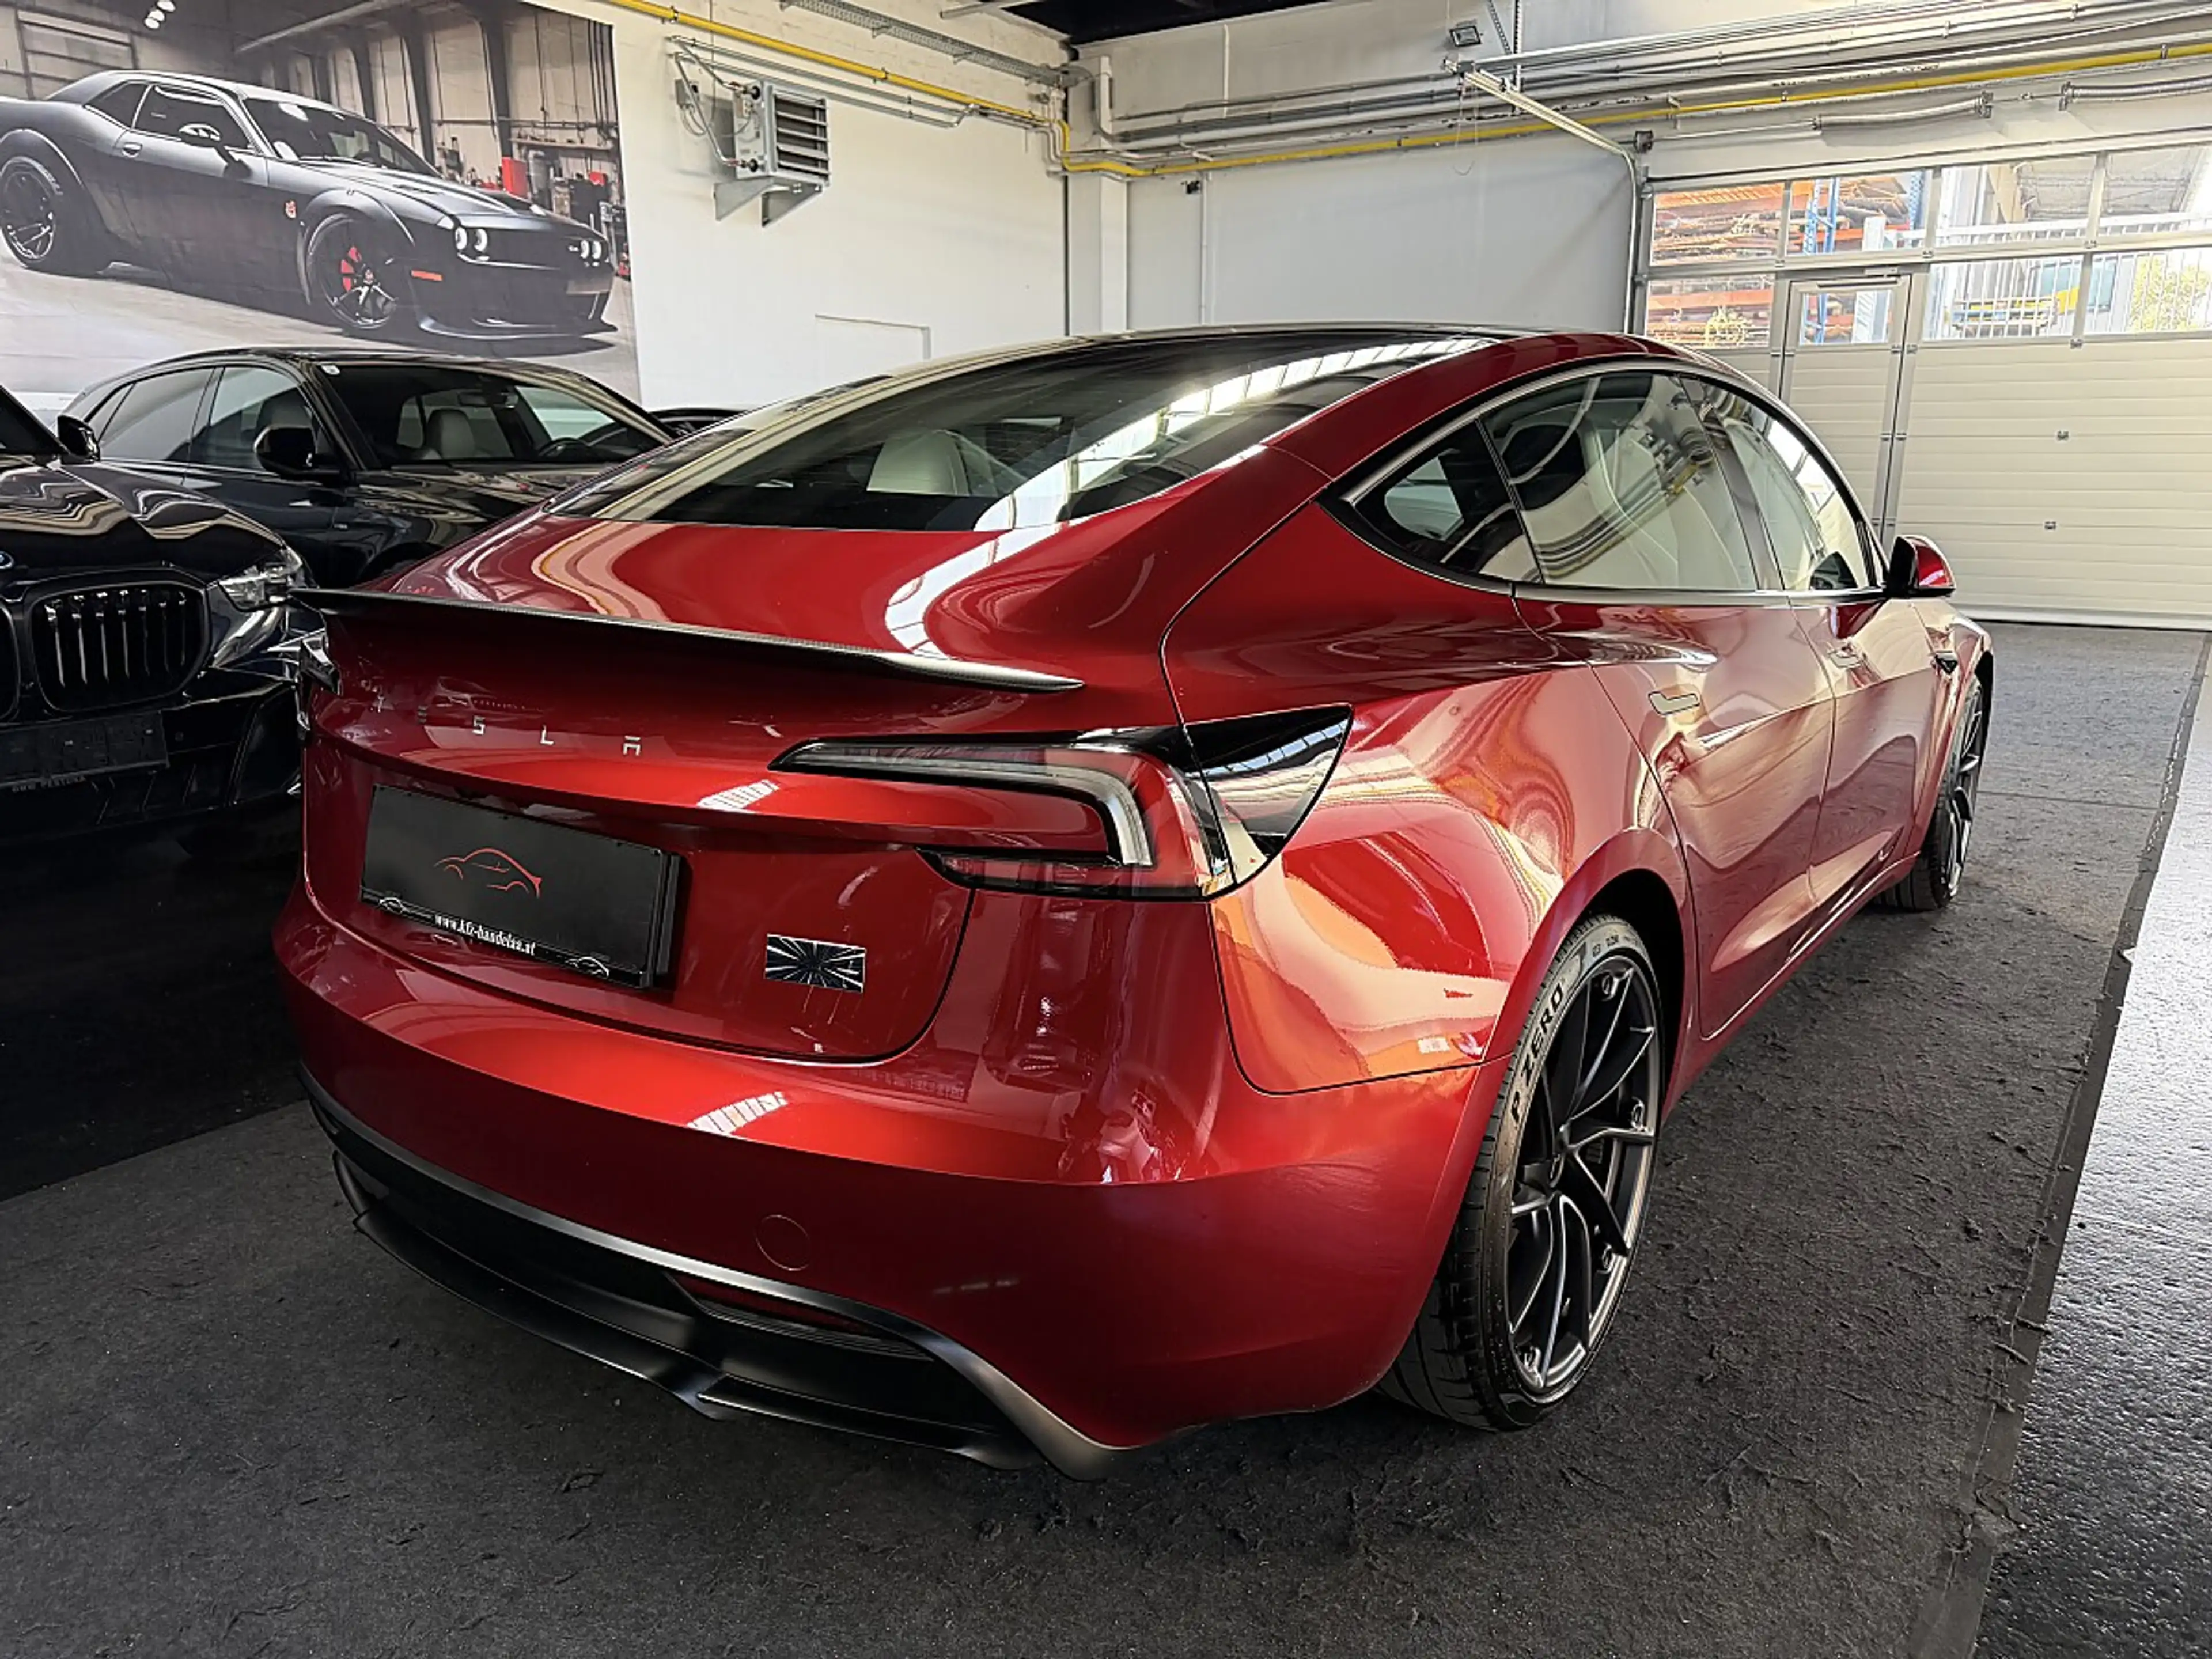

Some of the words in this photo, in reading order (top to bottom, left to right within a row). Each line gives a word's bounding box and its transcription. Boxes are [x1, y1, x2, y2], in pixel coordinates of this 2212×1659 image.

[377, 695, 641, 756] TESLA
[1509, 1090, 1521, 1123] P
[1520, 983, 1563, 1086] ZERO
